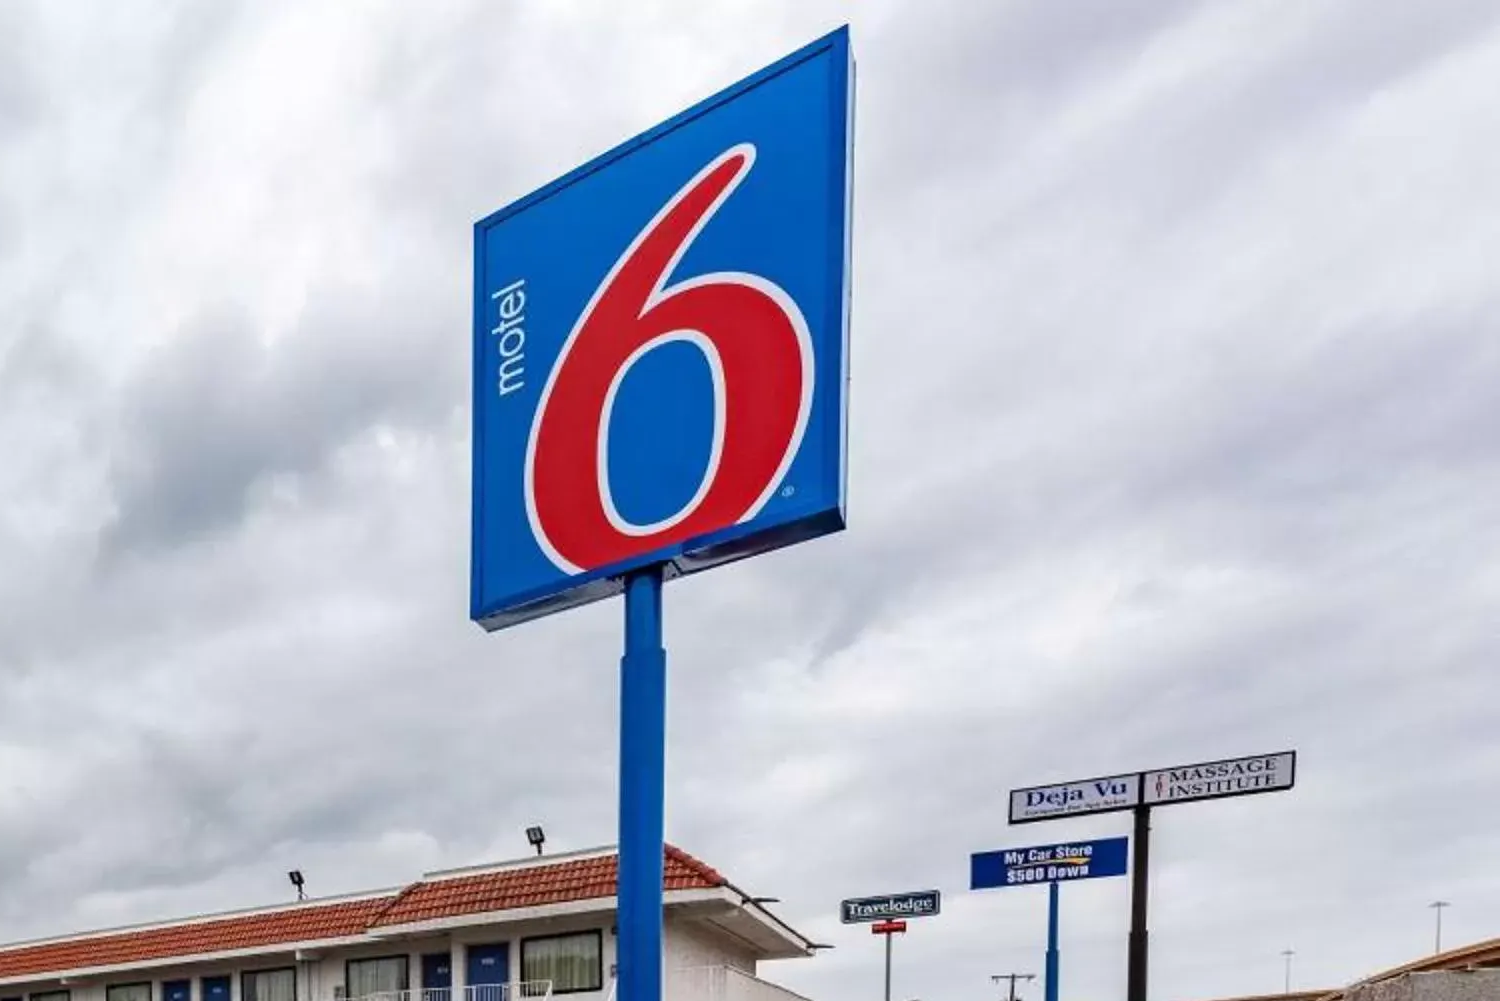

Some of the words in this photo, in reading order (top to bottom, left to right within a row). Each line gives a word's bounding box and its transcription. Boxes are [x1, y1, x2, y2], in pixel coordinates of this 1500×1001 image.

[491, 278, 525, 396] motel
[524, 142, 816, 577] 6
[1169, 757, 1277, 782] MASSAGE
[1026, 786, 1084, 807] Deja
[1094, 780, 1127, 798] Vu
[1169, 773, 1276, 798] INSTITUTE
[1003, 851, 1026, 865] My
[1027, 849, 1052, 862] Car
[1055, 845, 1093, 860] Store
[1006, 866, 1046, 884] $500
[1047, 864, 1090, 880] Down
[847, 897, 934, 917] Travelodge
